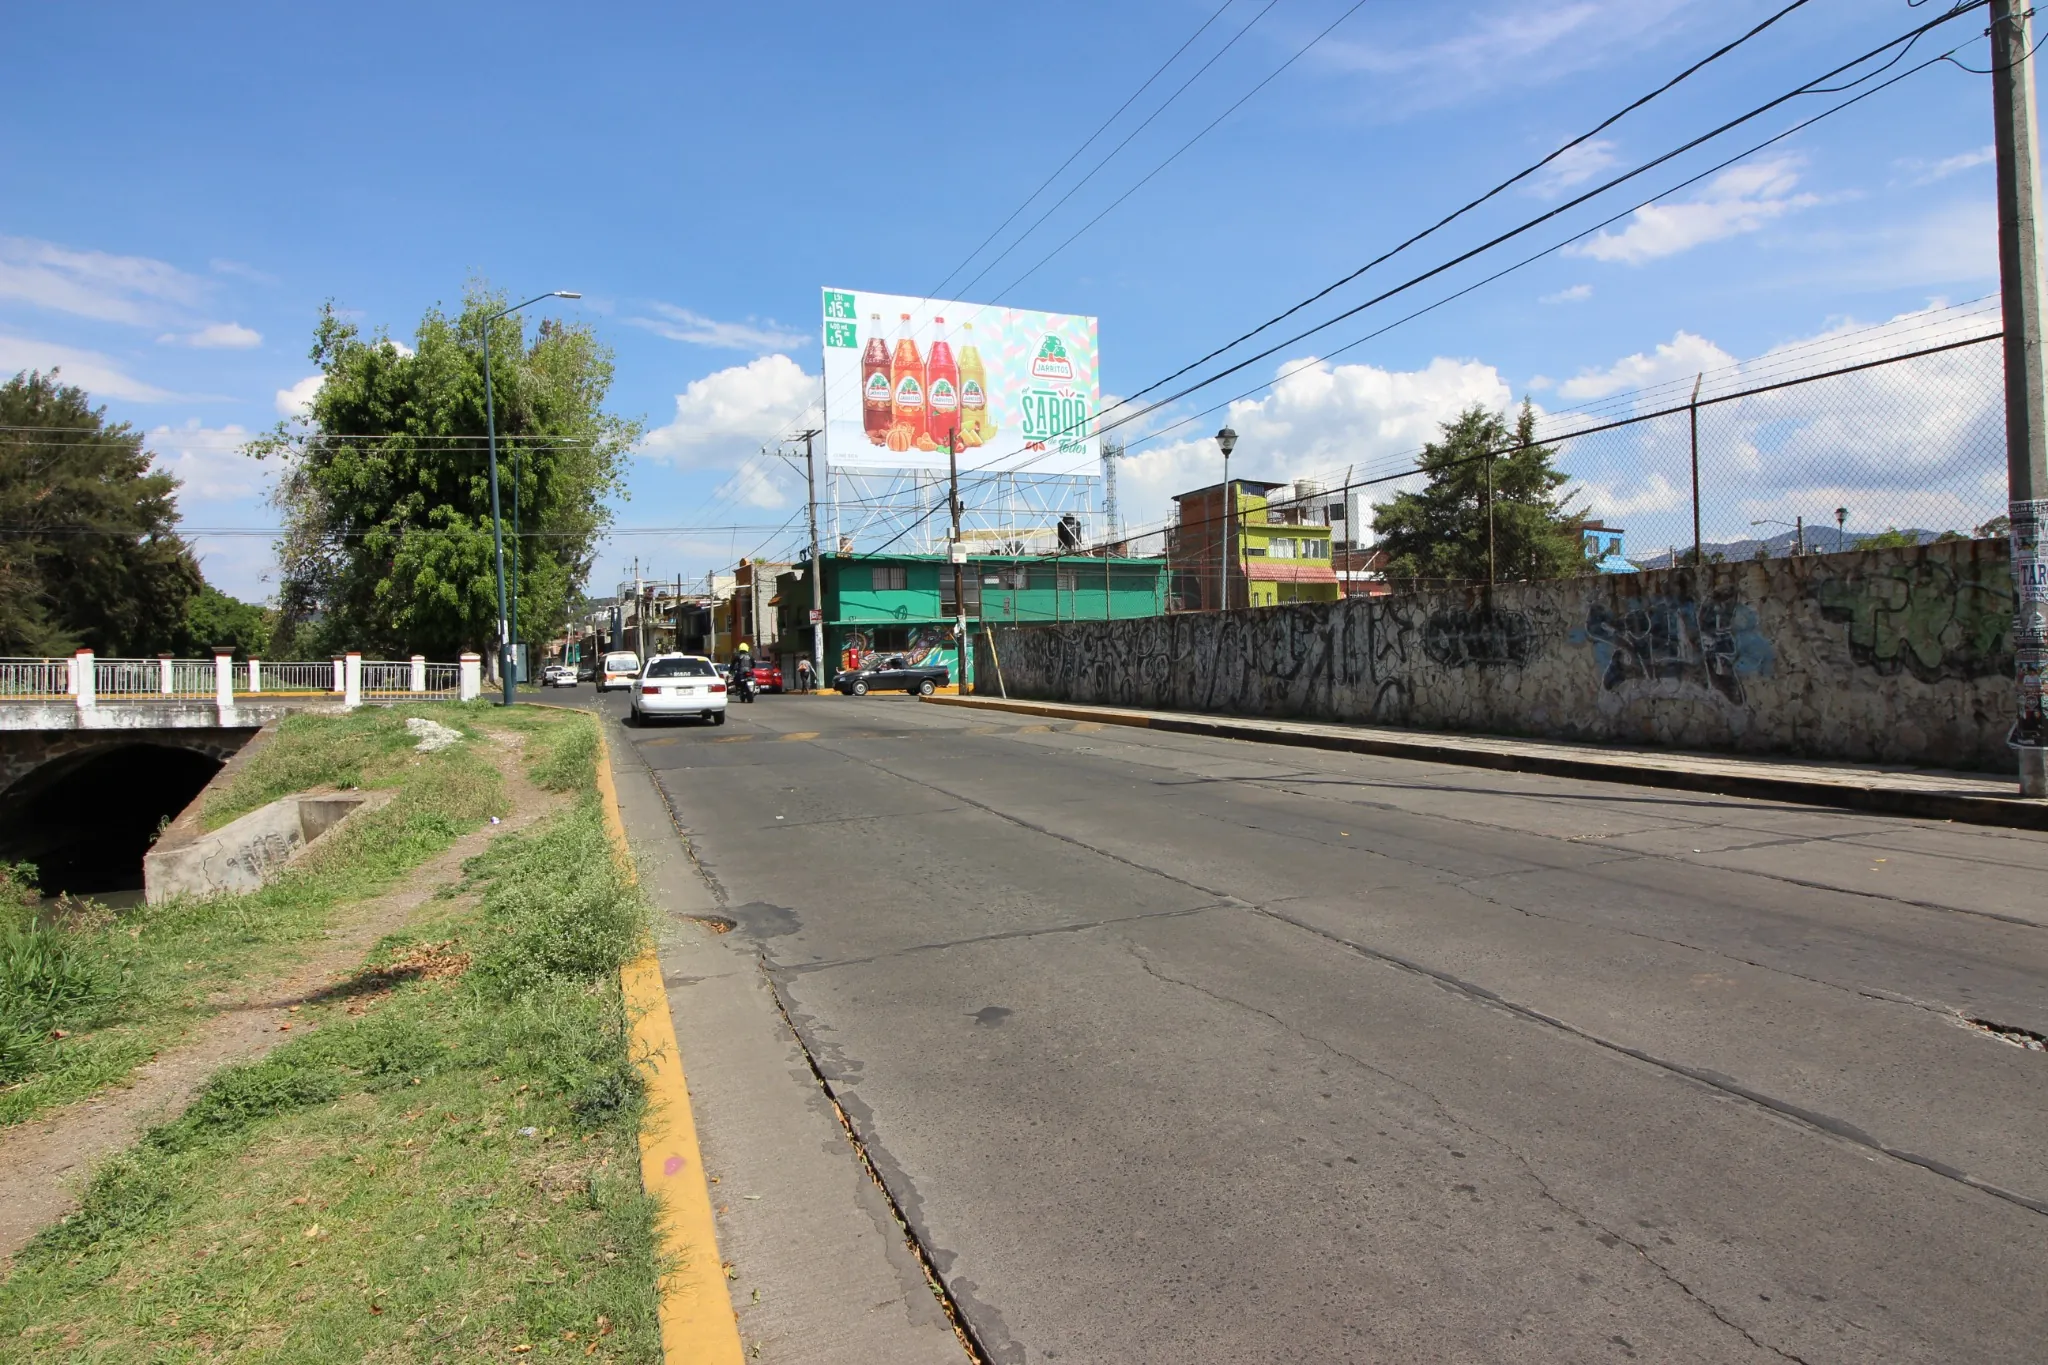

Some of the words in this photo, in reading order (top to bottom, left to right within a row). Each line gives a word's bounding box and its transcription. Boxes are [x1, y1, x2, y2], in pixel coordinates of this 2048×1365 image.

[1036, 364, 1069, 374] JARRITOS
[1022, 395, 1087, 438] SABOR
[2021, 564, 2048, 585] TAR
